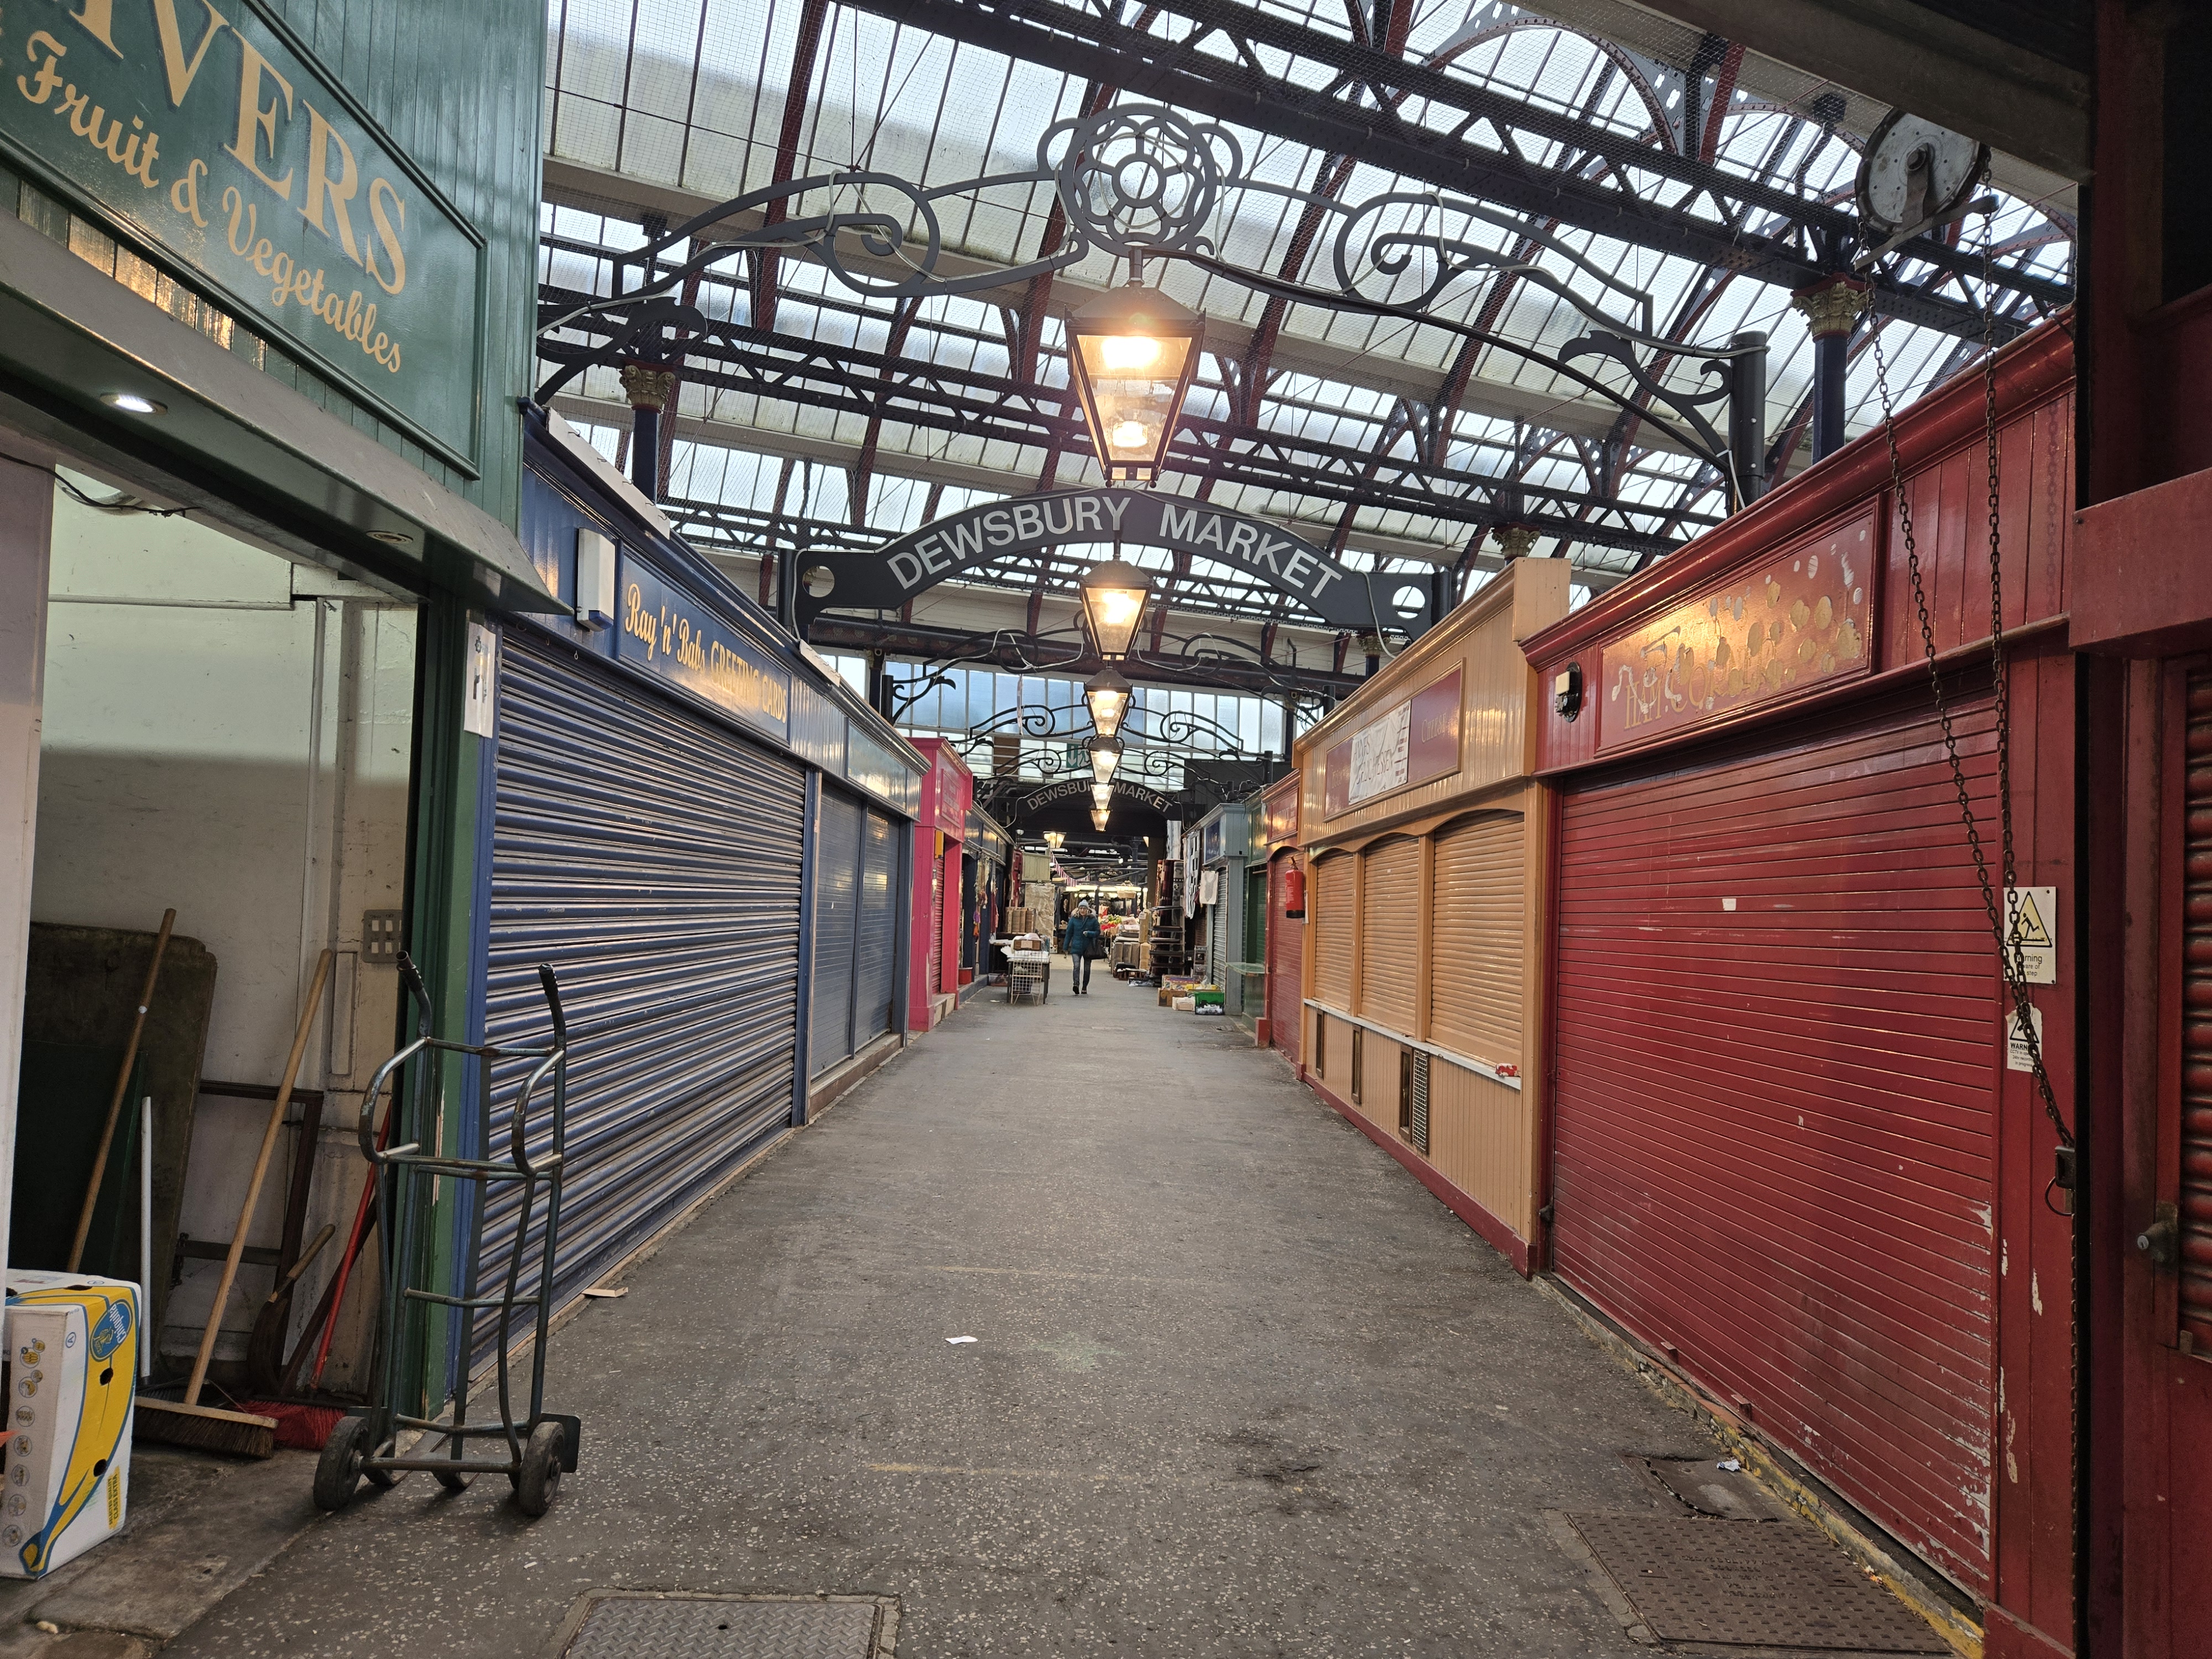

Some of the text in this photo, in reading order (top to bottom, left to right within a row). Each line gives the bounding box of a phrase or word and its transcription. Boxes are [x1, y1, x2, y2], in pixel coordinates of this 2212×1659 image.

[17, 30, 401, 373] Fruit & Vegetables
[67, 0, 406, 295] VERS
[886, 497, 1343, 599] DEWSBURY MARKET
[625, 583, 657, 661] Ray
[710, 640, 759, 707] GREETING
[761, 675, 787, 724] CARDS
[1027, 779, 1173, 813] DEWSBU MARKET
[108, 1303, 127, 1344] Chiquita
